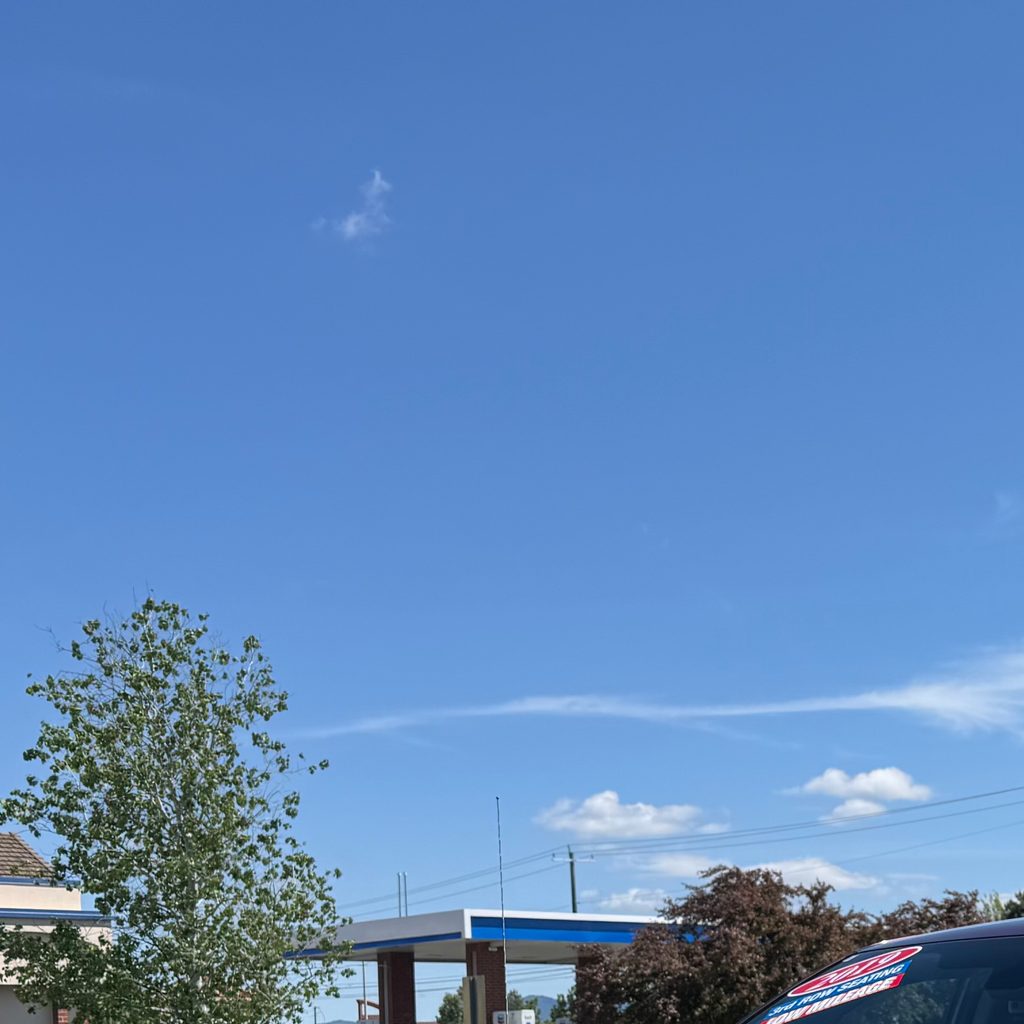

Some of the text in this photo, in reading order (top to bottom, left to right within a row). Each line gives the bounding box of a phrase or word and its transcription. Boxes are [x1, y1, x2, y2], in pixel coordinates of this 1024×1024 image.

[768, 963, 905, 1017] 3rd ROW SEATING
[804, 951, 902, 992] 2019
[805, 977, 897, 1015] MILEAGE
